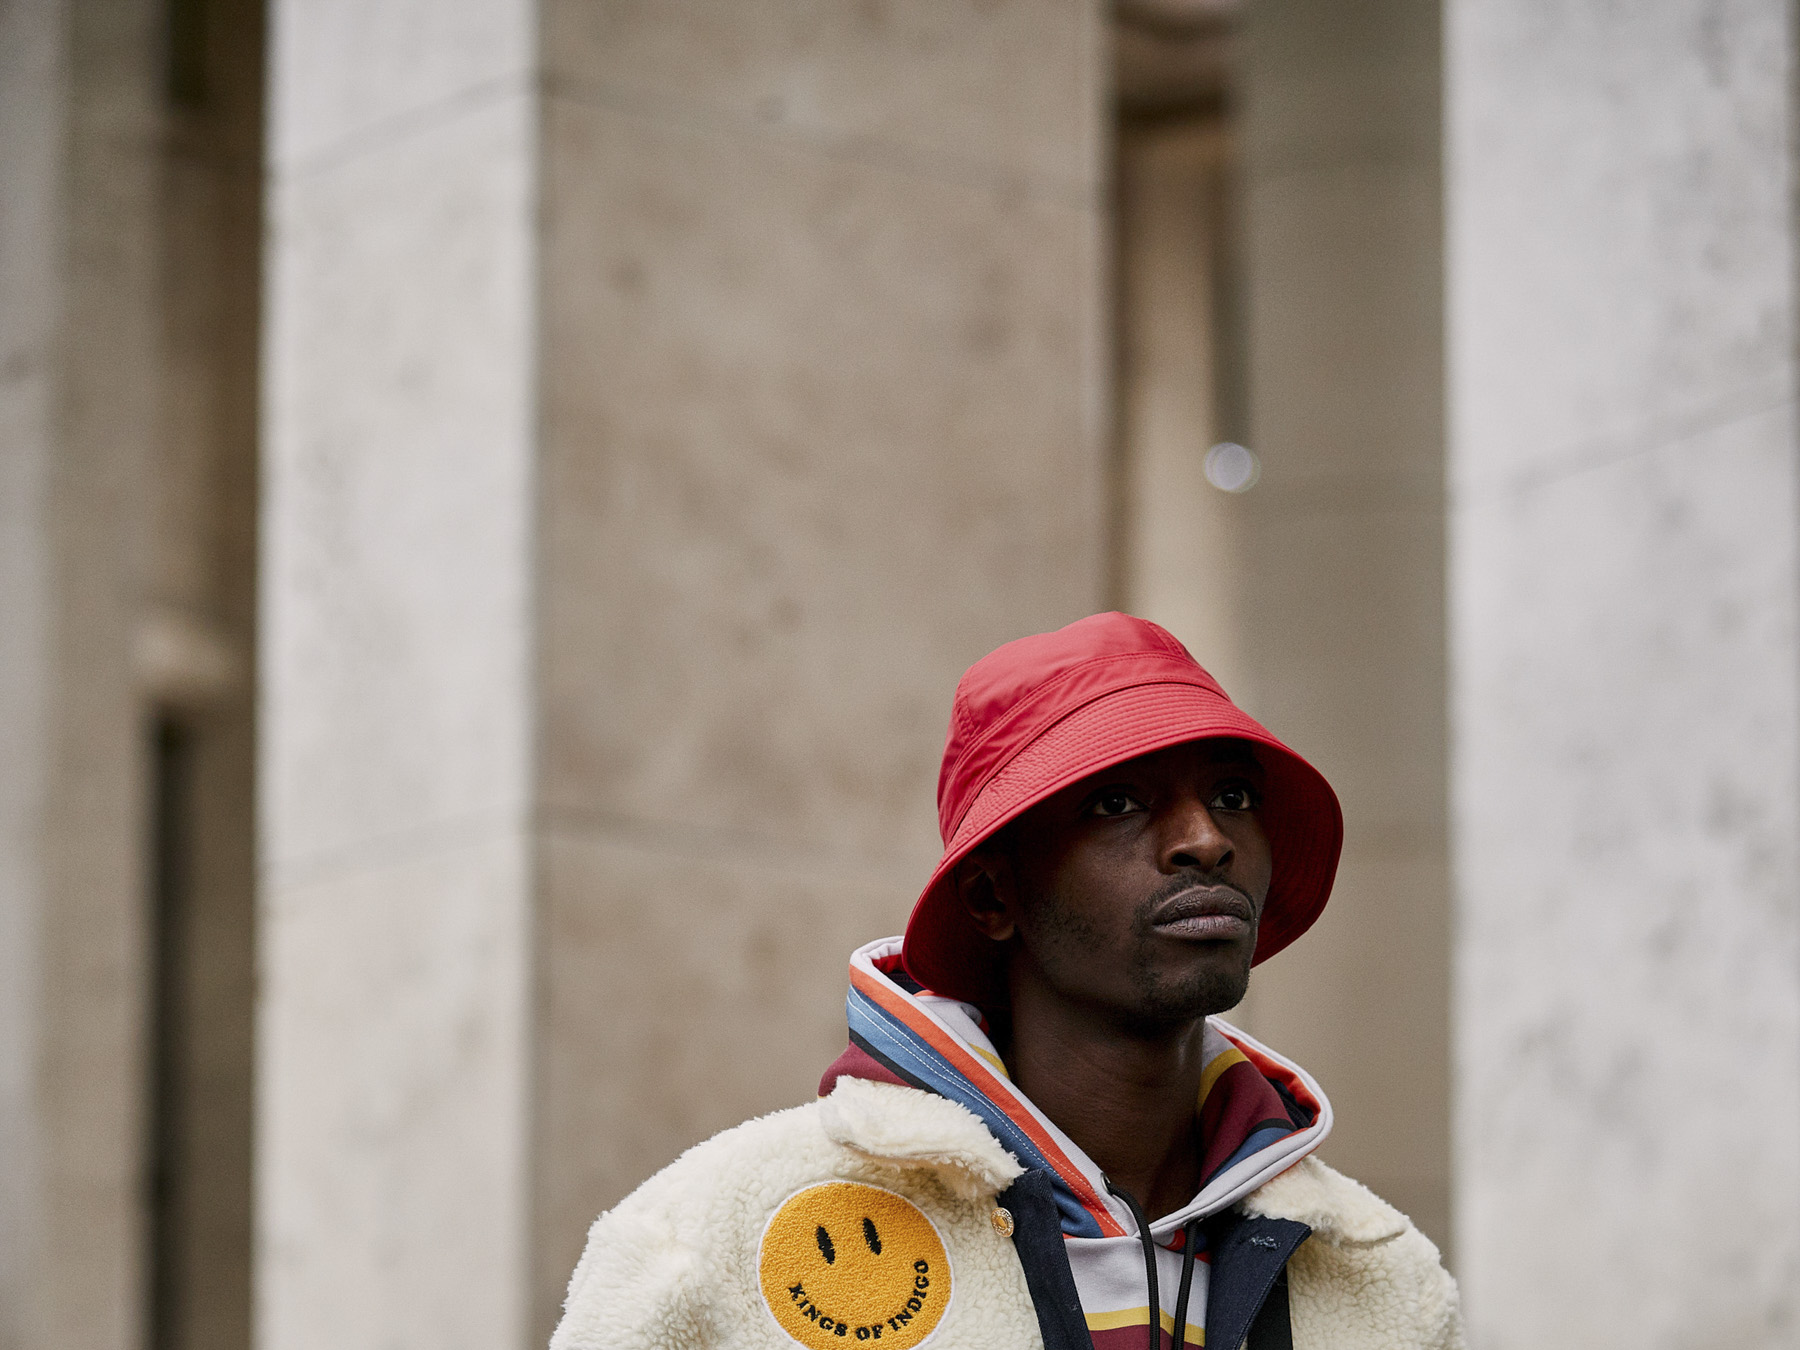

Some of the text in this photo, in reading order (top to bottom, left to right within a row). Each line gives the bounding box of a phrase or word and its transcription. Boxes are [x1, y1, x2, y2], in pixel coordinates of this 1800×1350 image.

[788, 1259, 929, 1341] KINGS OF INDIGO
